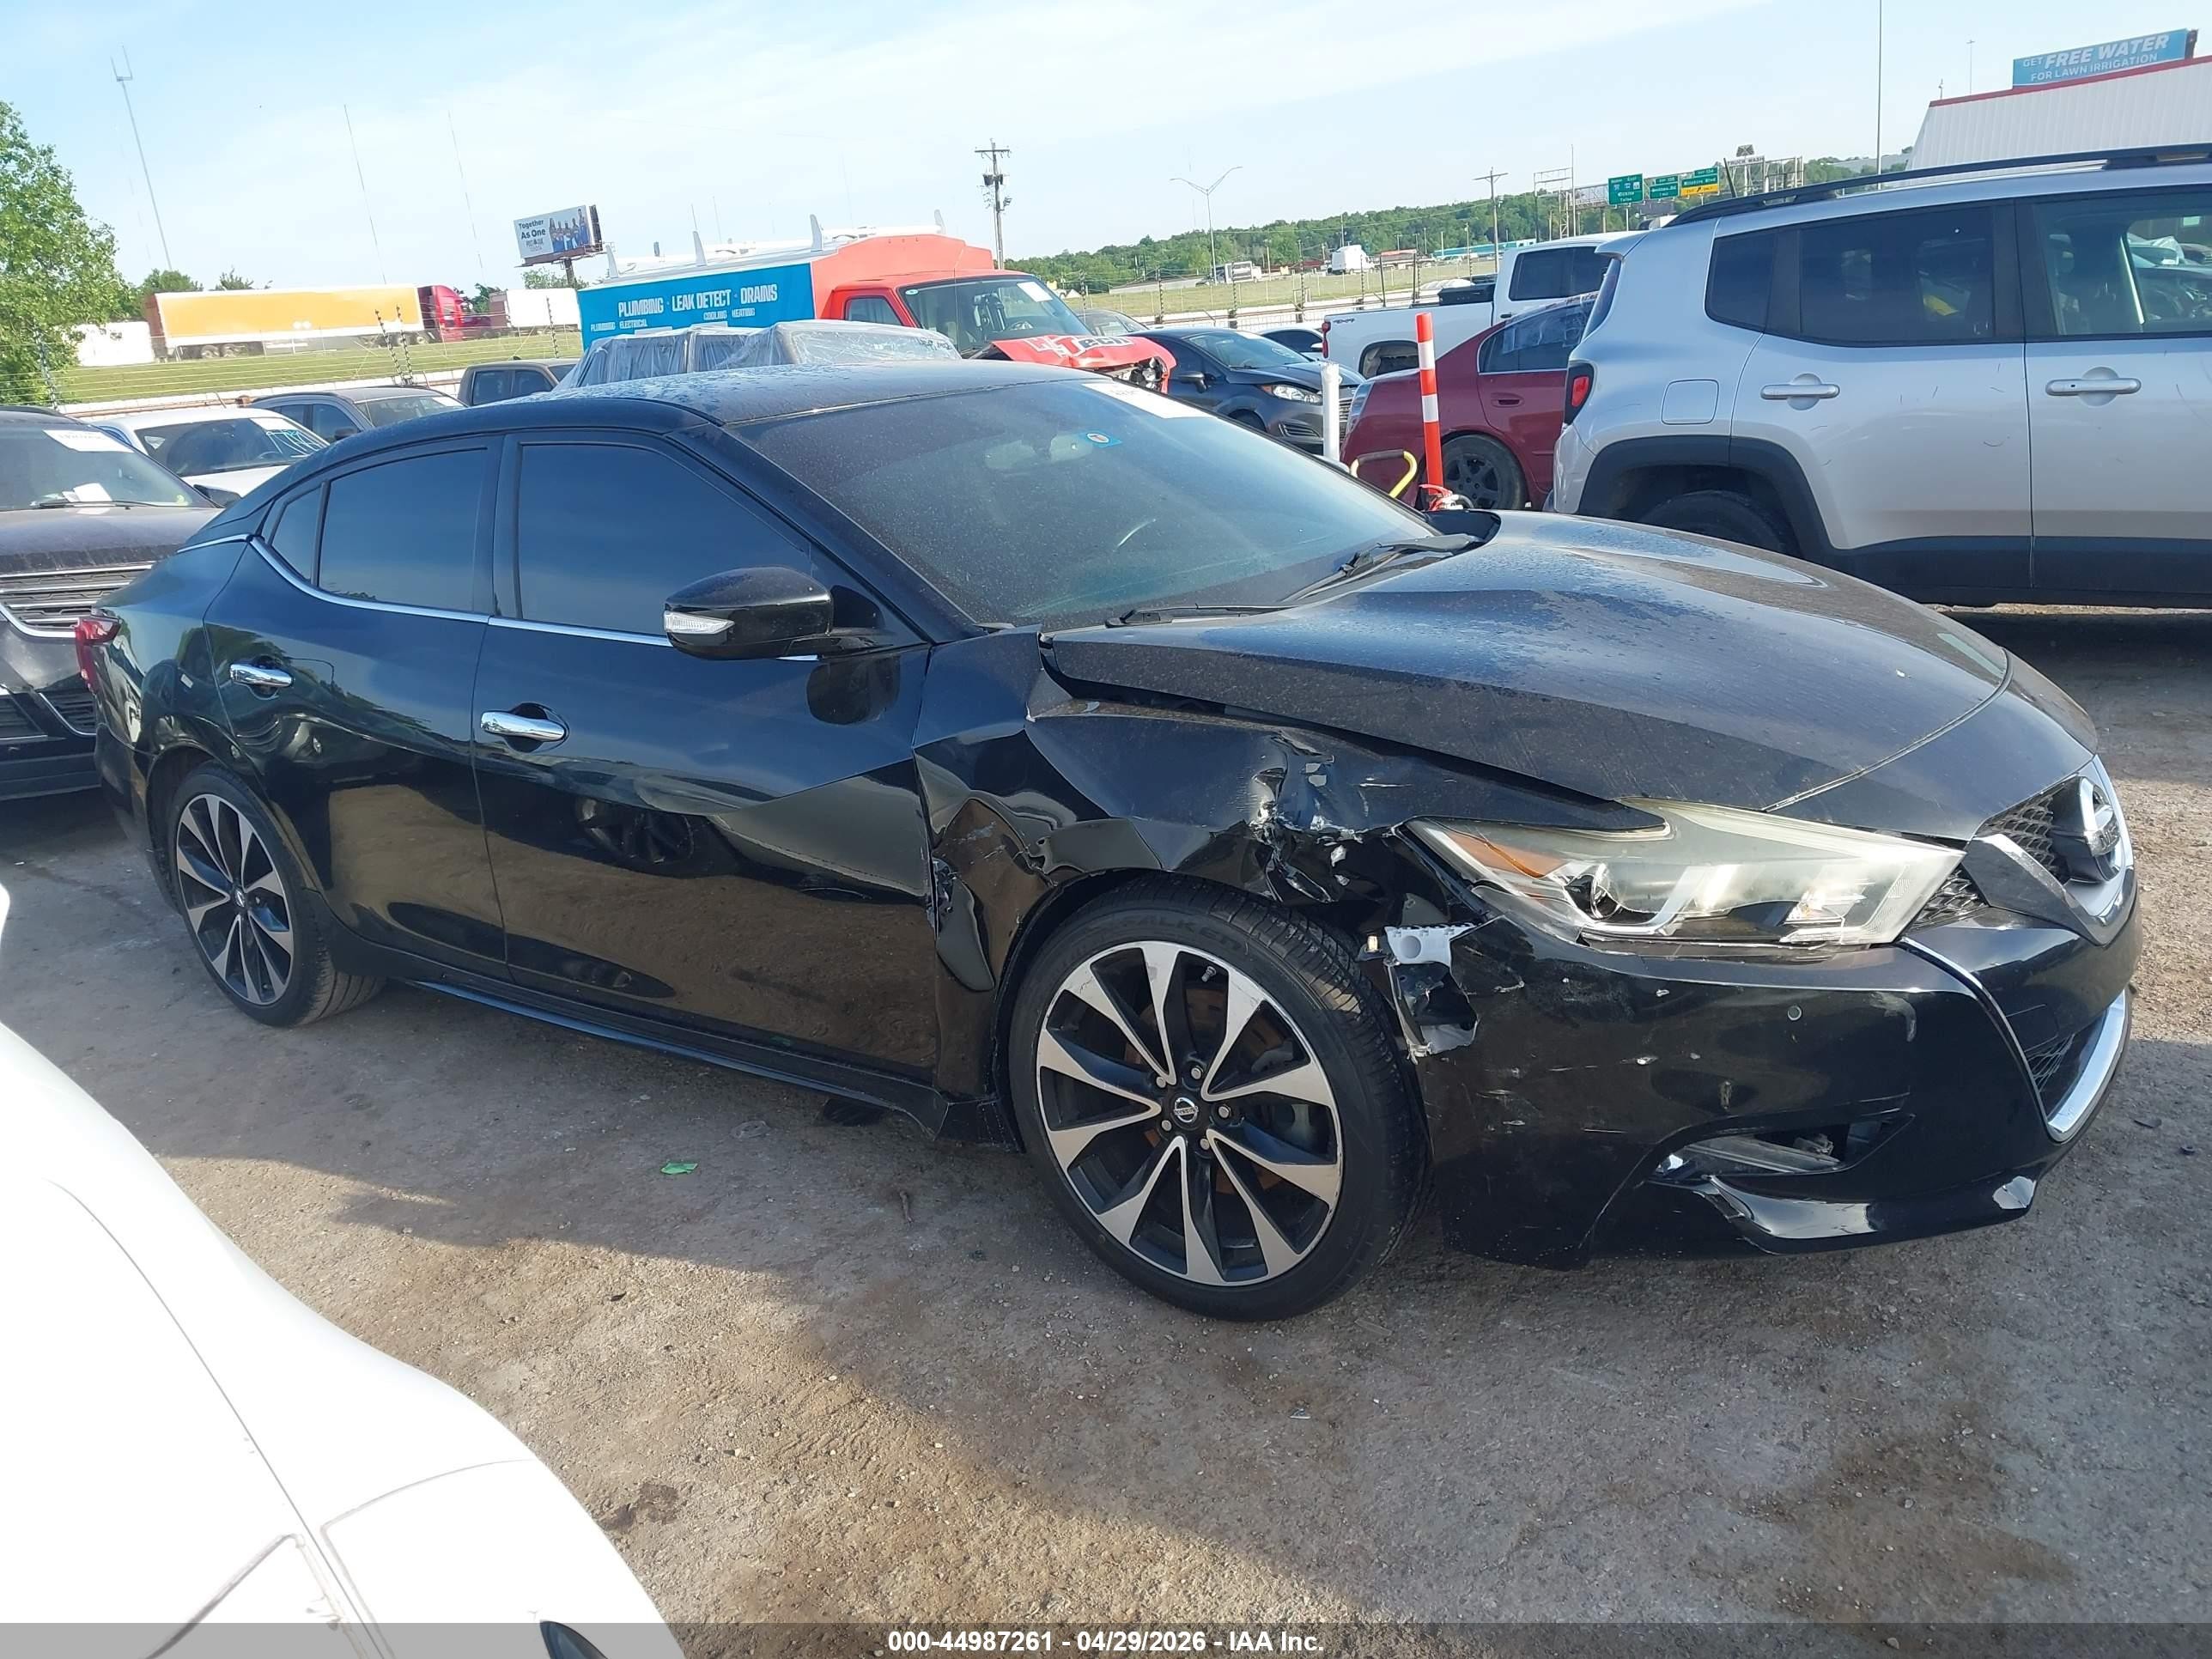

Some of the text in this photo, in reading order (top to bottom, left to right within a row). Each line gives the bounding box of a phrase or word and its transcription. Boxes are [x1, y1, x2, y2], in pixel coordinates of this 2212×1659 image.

[2023, 33, 2170, 70] GET FREE WATER
[2031, 52, 2158, 82] FOR LAWN IRRIGATION
[519, 219, 544, 229] Together
[520, 228, 546, 240] As One
[618, 283, 778, 318] PLUMBING LEAK DETECT DRAINS
[732, 307, 756, 318] HEATING
